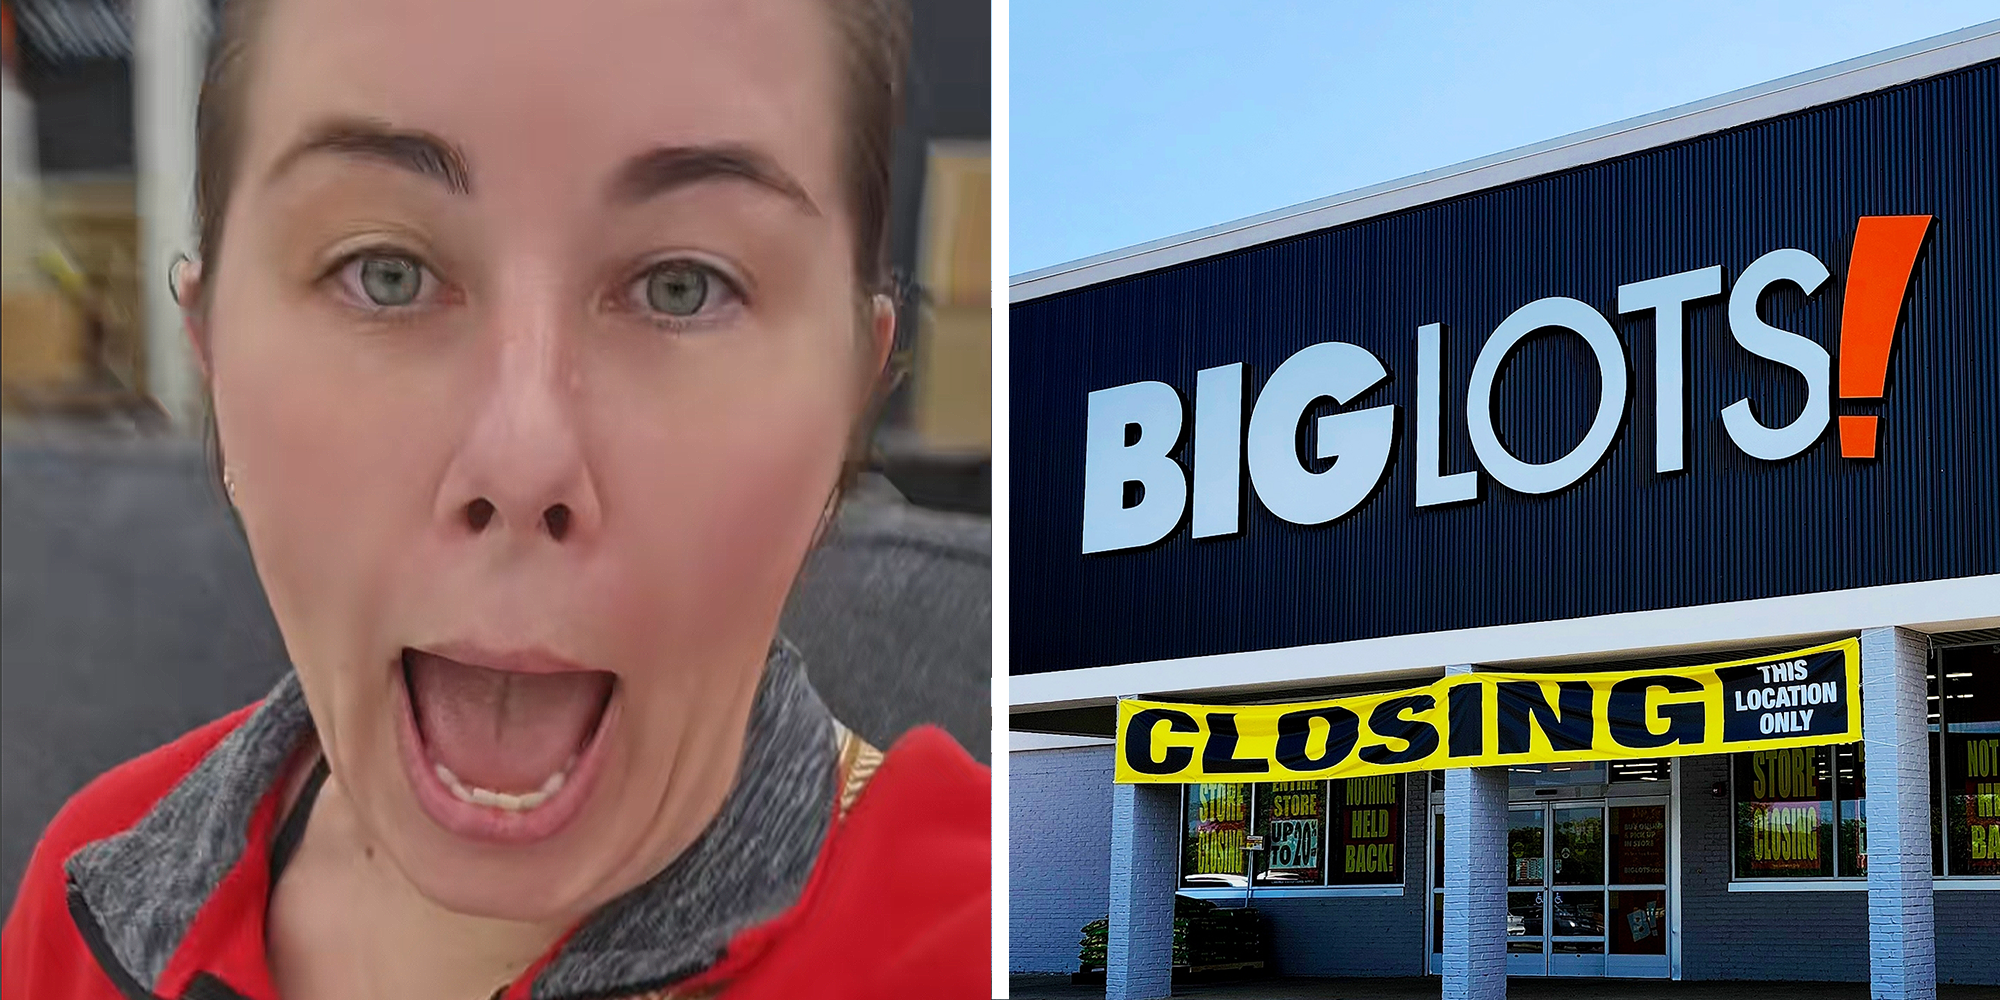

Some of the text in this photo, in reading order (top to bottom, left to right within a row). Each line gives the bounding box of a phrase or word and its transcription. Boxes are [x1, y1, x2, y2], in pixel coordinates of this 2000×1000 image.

[1082, 214, 1933, 555] BIG LOTS!
[1757, 659, 1808, 684] THIS
[1735, 681, 1838, 712] LOCATION
[1124, 674, 1706, 775] CLOSING
[1759, 709, 1814, 735] ONLY
[1753, 748, 1817, 799] STORE
[1200, 783, 1244, 823] STORE
[1273, 794, 1318, 817] STORE
[1346, 775, 1396, 806] NOTHING
[1272, 822, 1293, 843] UP
[1351, 809, 1389, 839] HELD
[1754, 806, 1818, 861] CLOSING
[1198, 829, 1243, 874] CLOSING
[1271, 845, 1291, 866] TO
[1345, 843, 1394, 873] BACK!
